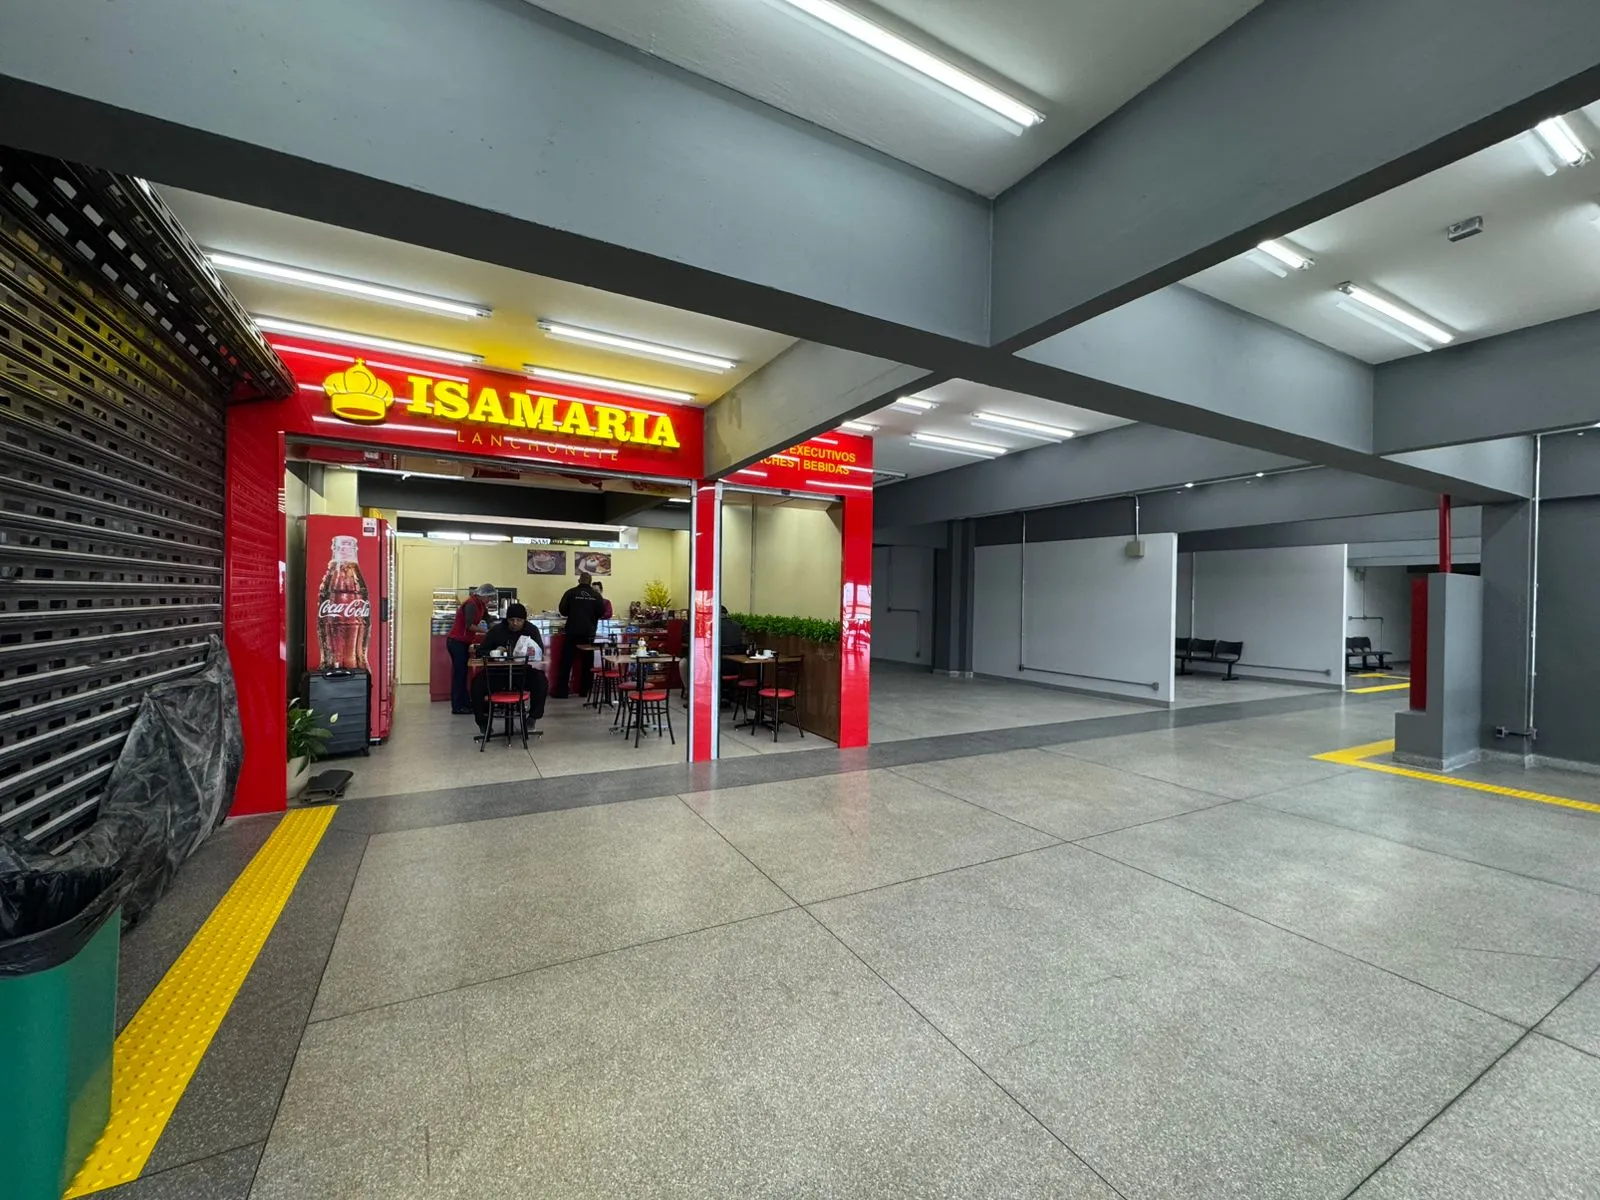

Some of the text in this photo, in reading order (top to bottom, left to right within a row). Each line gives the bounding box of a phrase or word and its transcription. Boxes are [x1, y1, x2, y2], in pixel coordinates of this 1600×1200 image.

[407, 375, 680, 448] ISAMARIA
[456, 430, 619, 462] LANCHONETE
[789, 445, 856, 463] EXECUTIVOS
[803, 459, 850, 475] BEBIDAS
